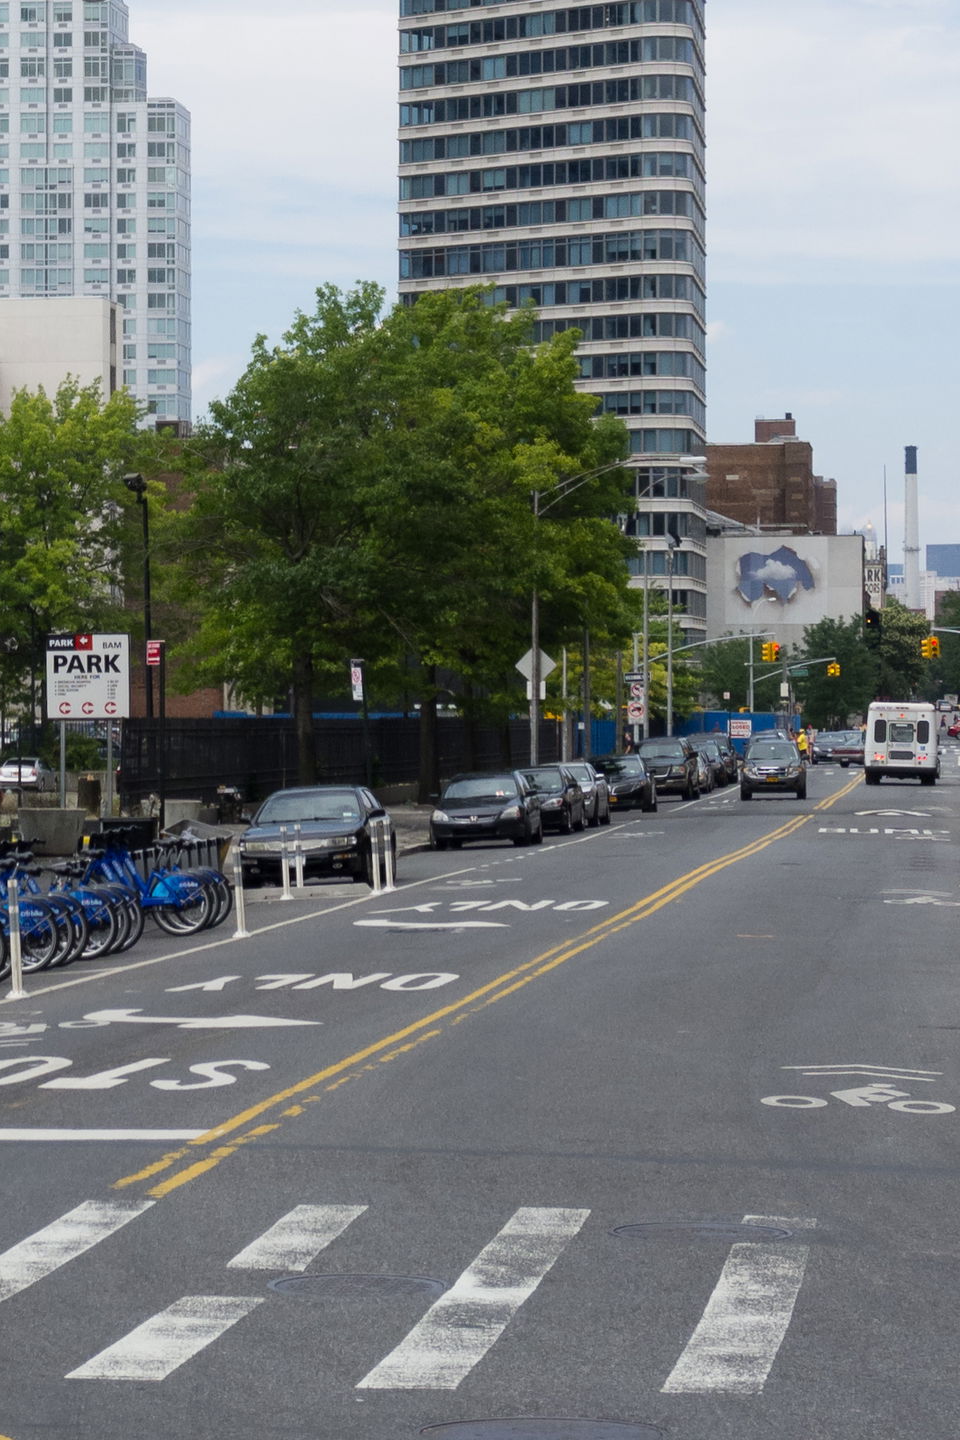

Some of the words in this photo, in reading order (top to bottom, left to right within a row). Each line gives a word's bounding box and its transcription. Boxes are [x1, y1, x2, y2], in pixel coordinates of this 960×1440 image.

[49, 639, 74, 647] PARK
[53, 654, 121, 674] PARK
[367, 900, 609, 914] ONLY
[165, 972, 460, 992] ONLY
